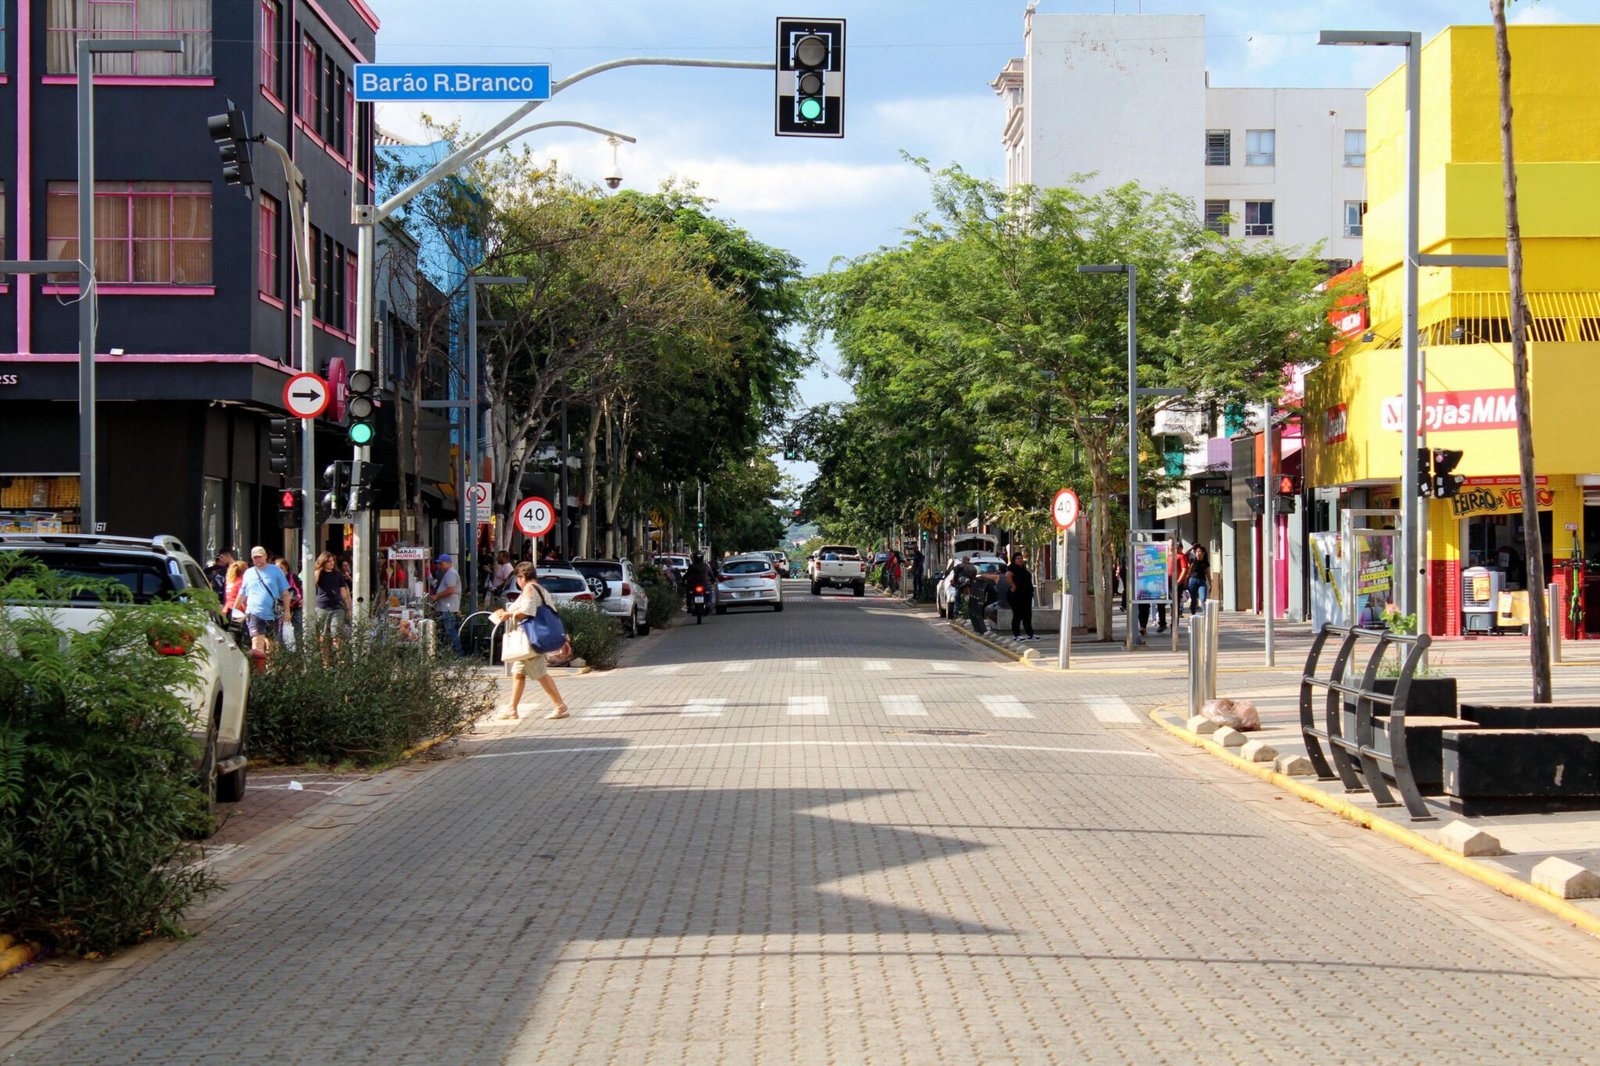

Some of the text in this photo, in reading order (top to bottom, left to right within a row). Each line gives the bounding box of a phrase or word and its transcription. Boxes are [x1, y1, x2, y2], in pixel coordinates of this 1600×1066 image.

[362, 72, 533, 92] Barão R.Branco
[1425, 395, 1517, 430] ojasMM
[1057, 500, 1071, 513] 40
[1453, 487, 1498, 515] FEIRÃO
[1500, 487, 1554, 509] VEO
[524, 508, 545, 521] 40
